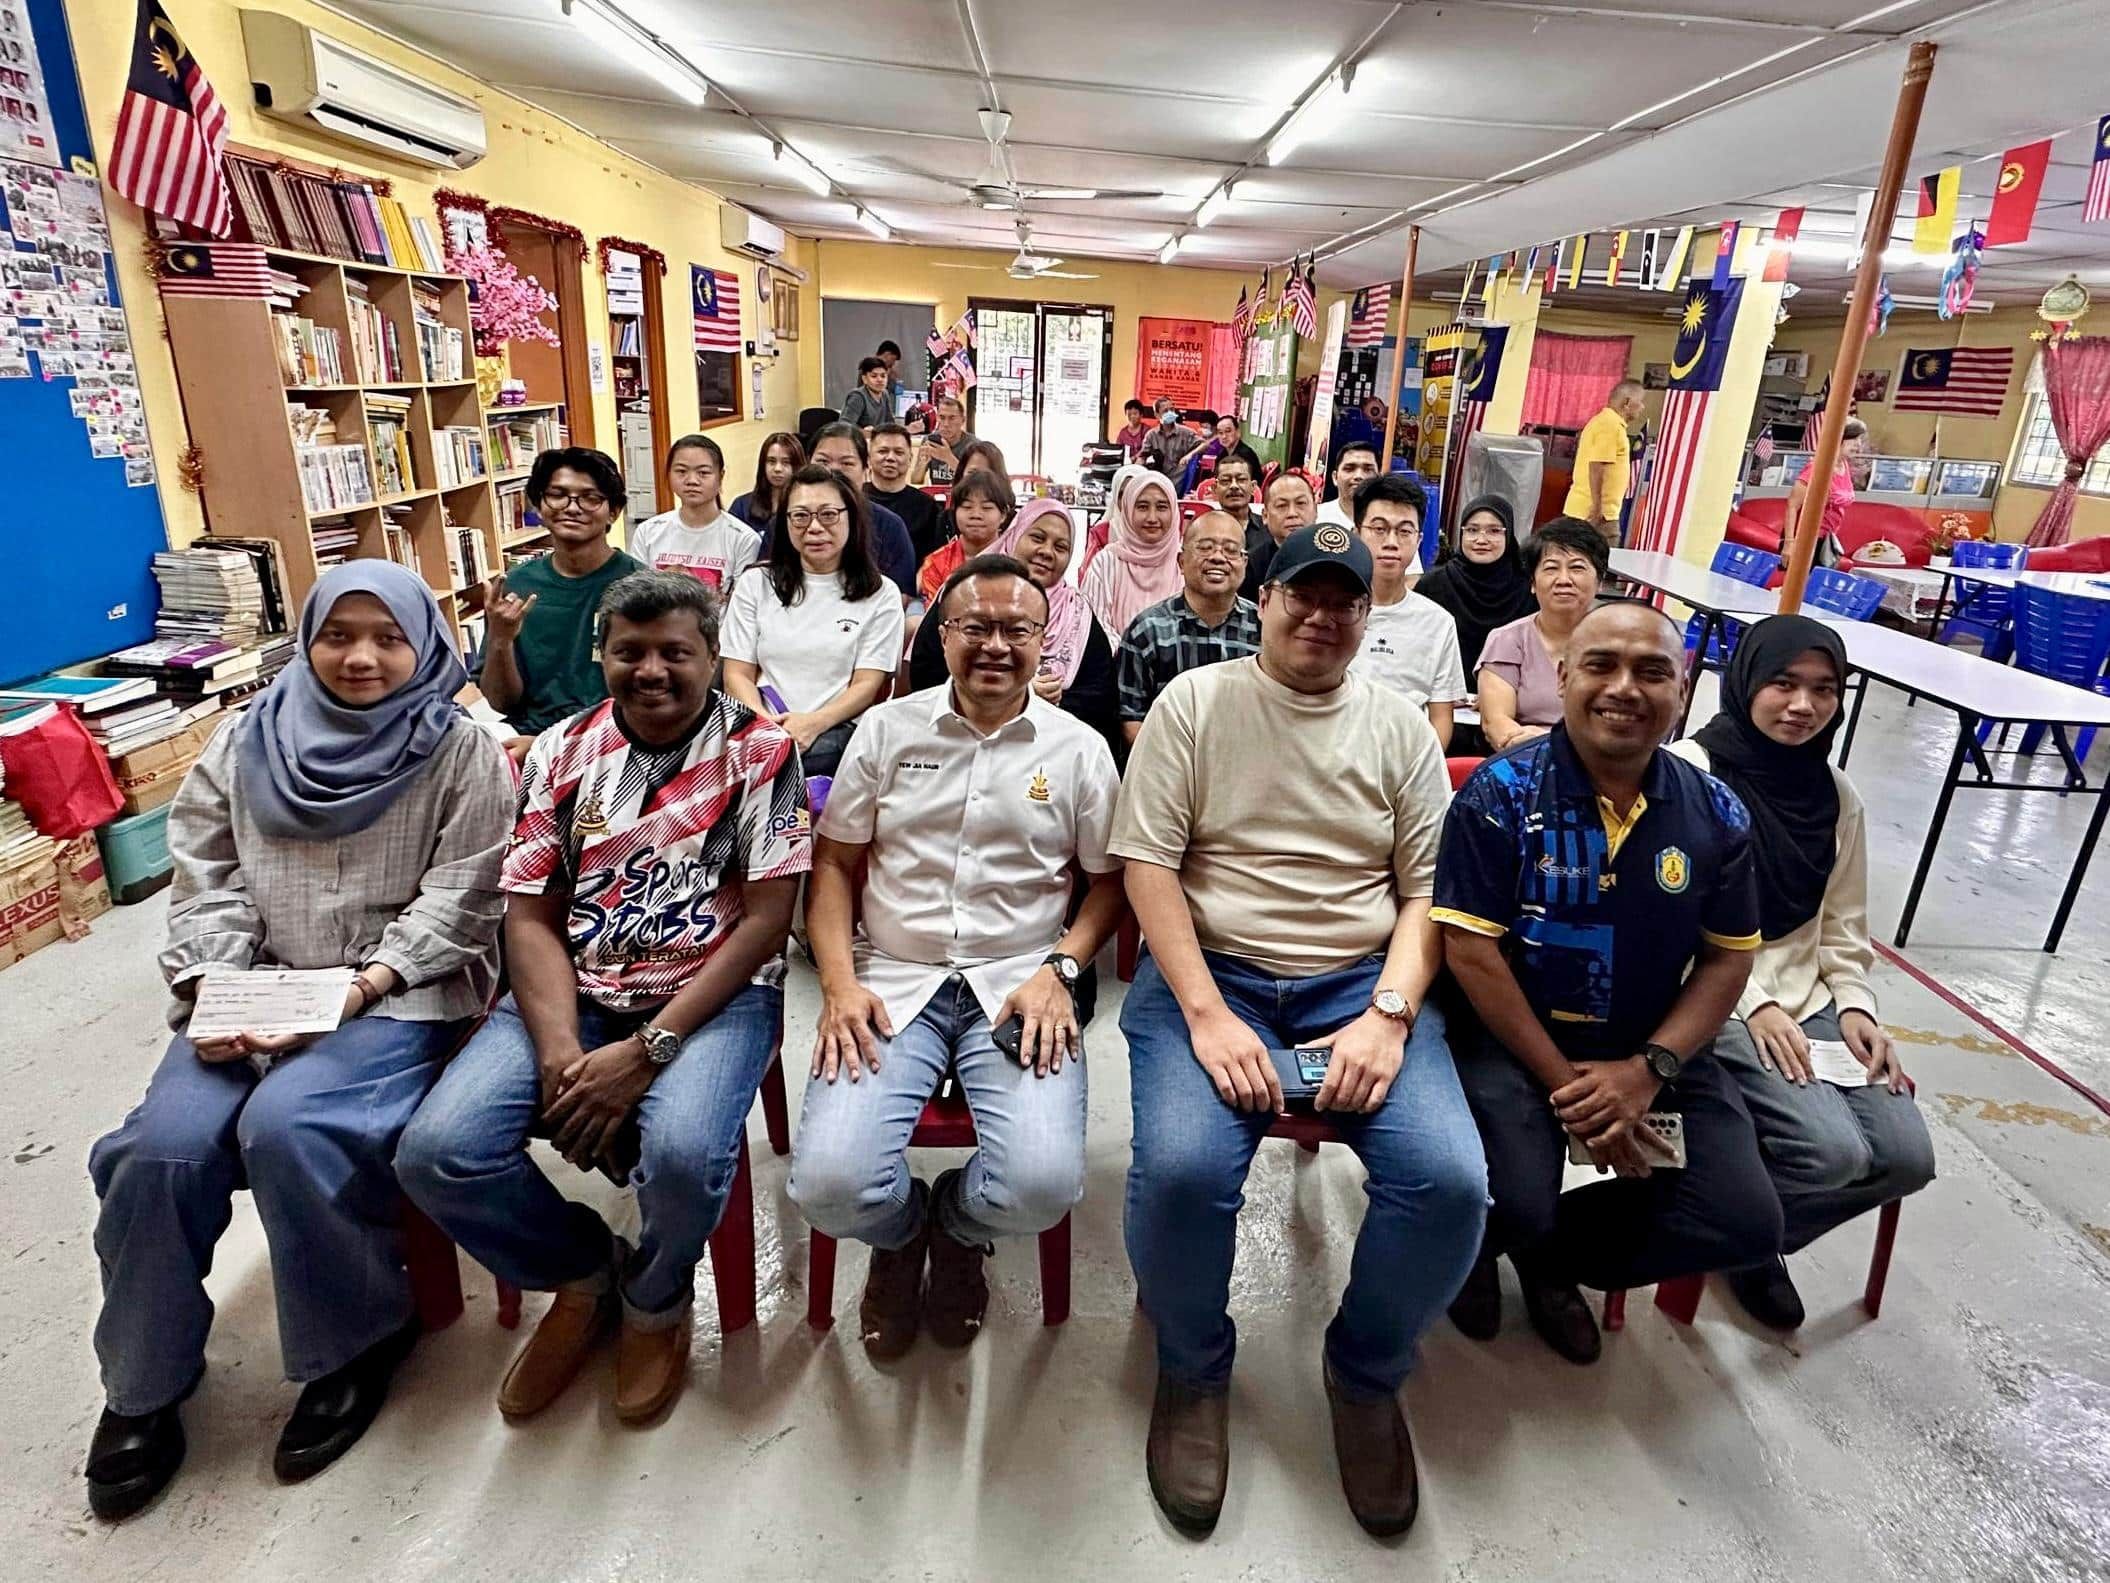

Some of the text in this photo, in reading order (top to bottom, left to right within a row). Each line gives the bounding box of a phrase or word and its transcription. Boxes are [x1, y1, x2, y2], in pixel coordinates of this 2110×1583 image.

[1152, 340, 1203, 352] BERSATU!
[1150, 368, 1190, 376] WANITA
[0, 884, 60, 926] EXUS
[641, 944, 705, 962] TERATAI
